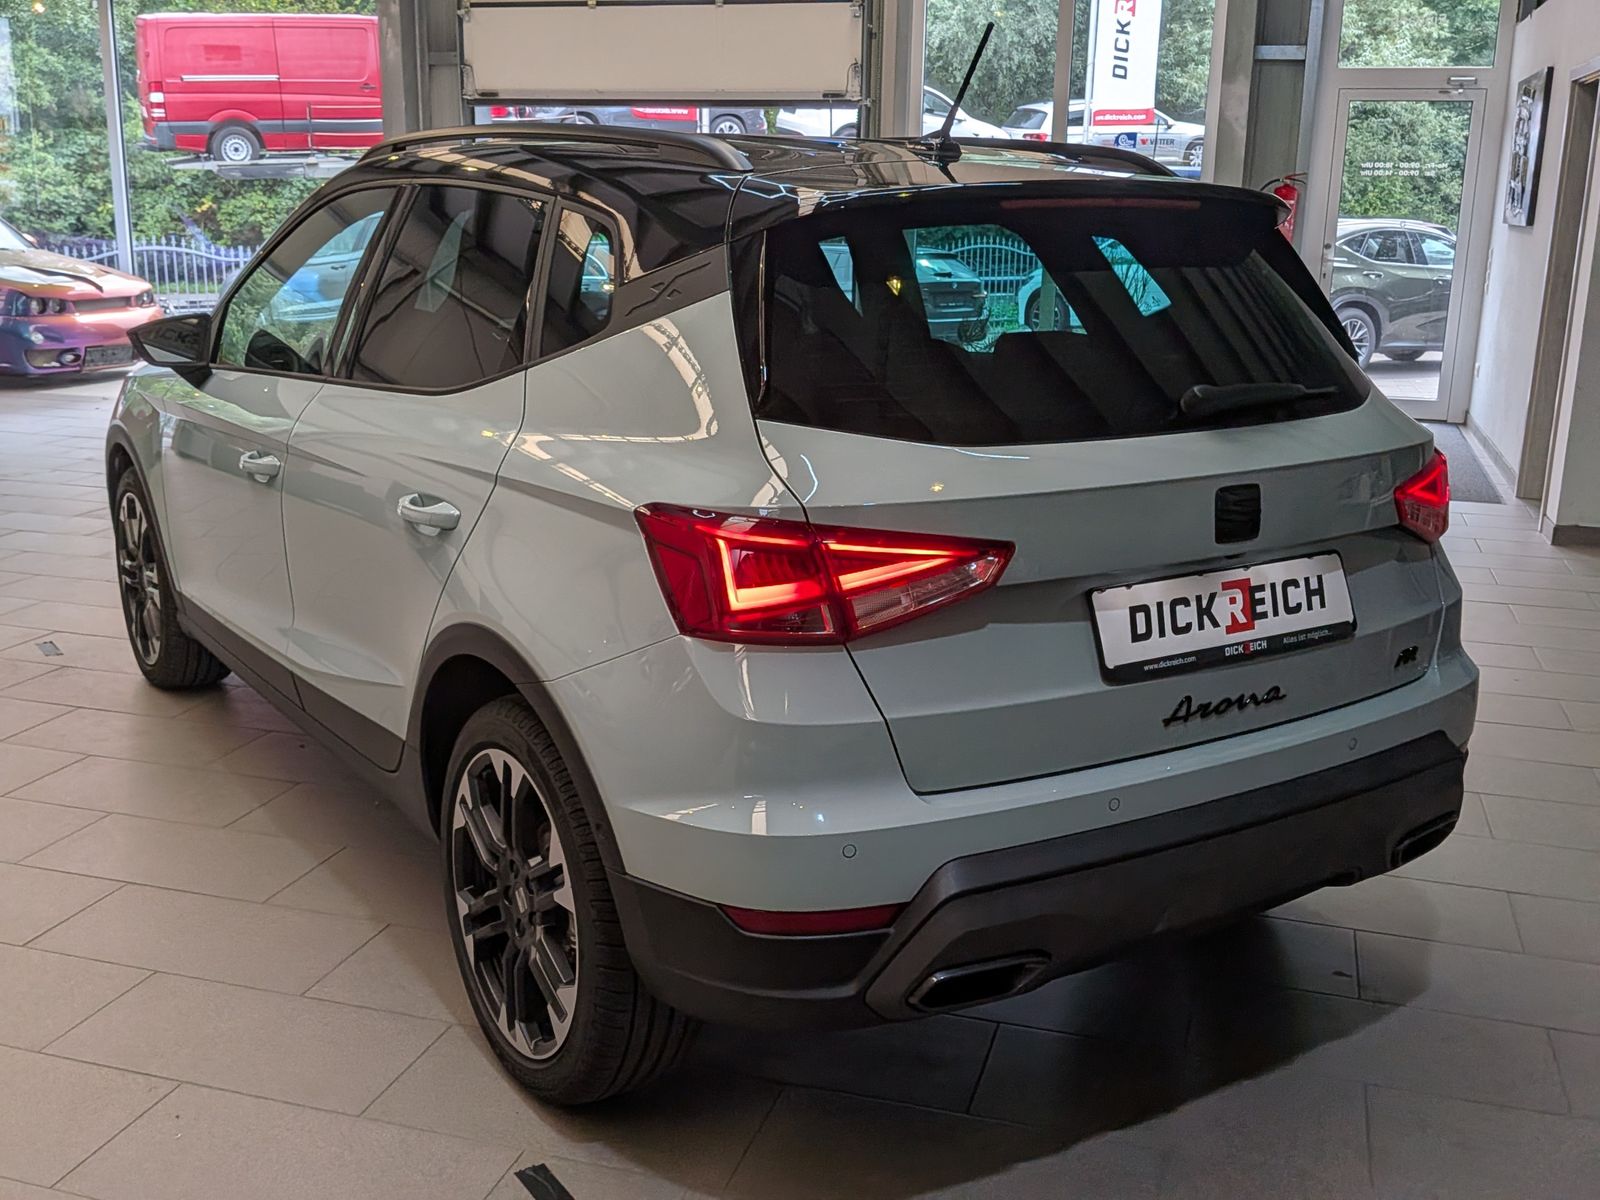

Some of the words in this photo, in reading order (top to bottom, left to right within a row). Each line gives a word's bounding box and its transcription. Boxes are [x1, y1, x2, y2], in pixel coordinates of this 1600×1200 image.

[1129, 574, 1327, 643] DICKREICH
[1143, 655, 1197, 671] www.dickreich.com
[1162, 684, 1287, 728] Arona
